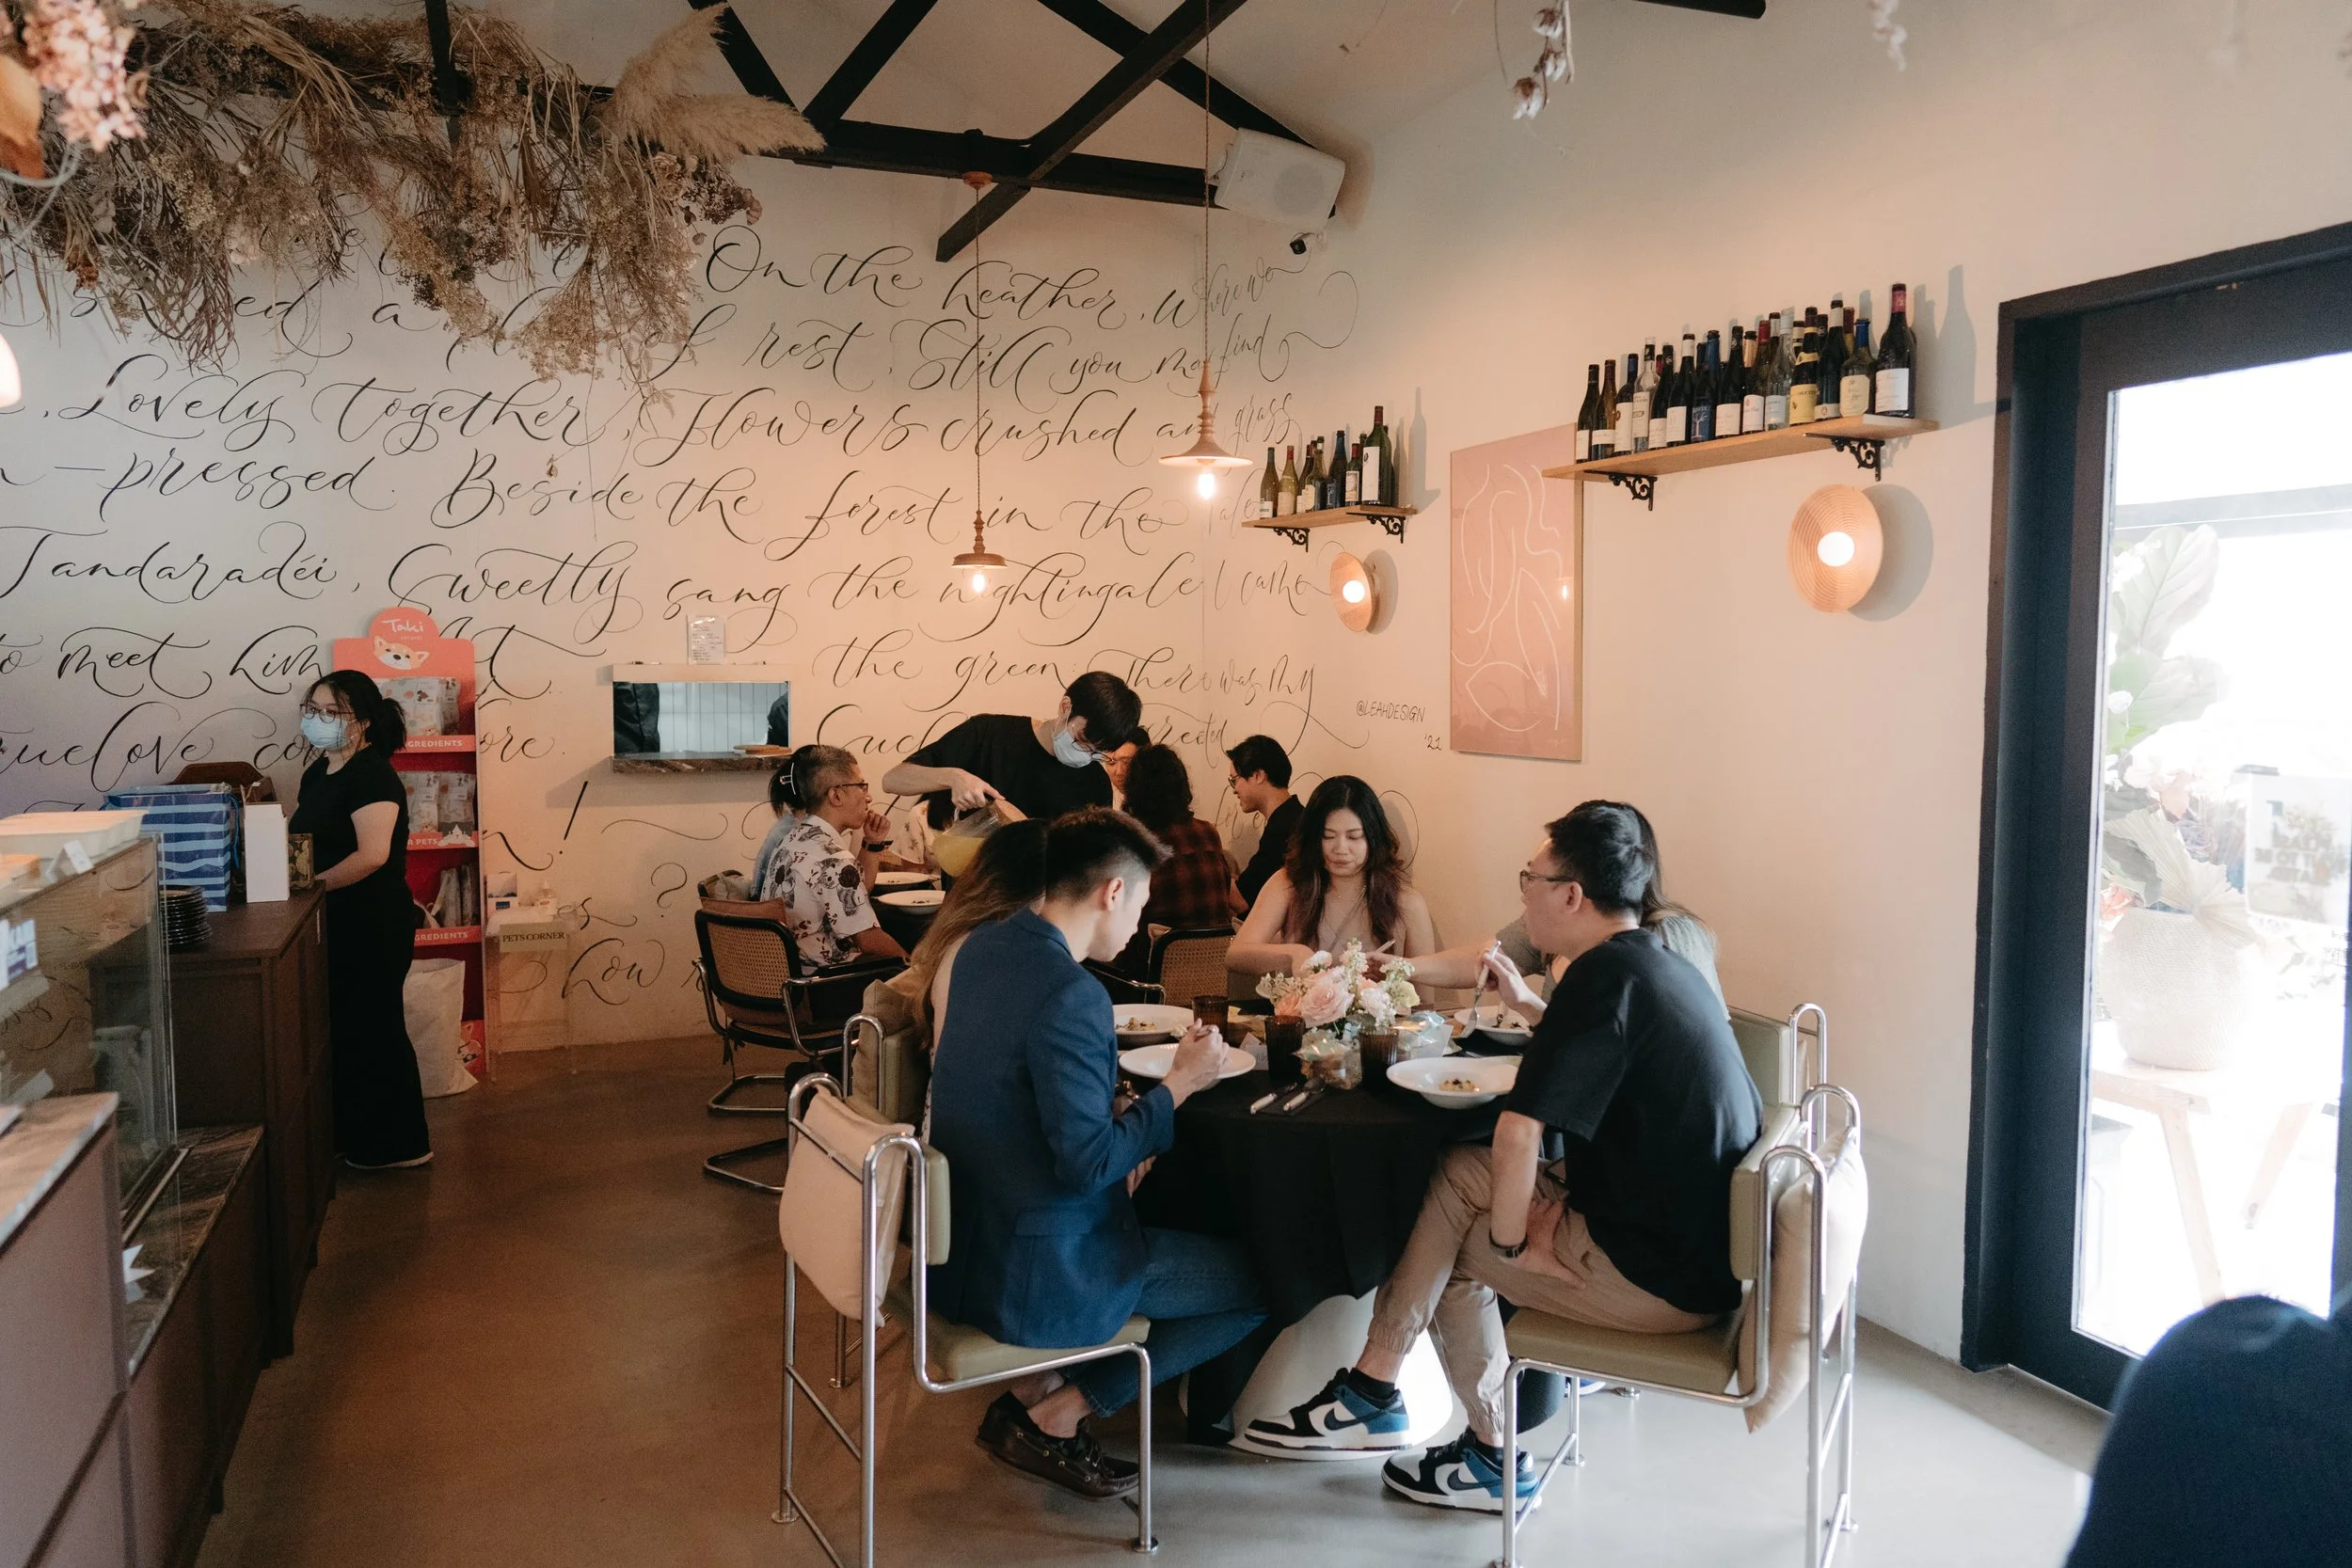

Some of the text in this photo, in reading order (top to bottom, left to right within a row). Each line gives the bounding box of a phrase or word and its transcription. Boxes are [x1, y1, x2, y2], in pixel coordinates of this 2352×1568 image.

[706, 225, 807, 293] On
[810, 245, 923, 308] the
[890, 319, 1072, 414] Still
[1049, 351, 1152, 394] you
[58, 354, 306, 451] Lovely
[633, 387, 929, 467] Flowers
[941, 389, 1153, 467] crushed
[1156, 403, 1218, 440] an
[431, 449, 644, 529] Beside
[657, 467, 764, 544] the
[764, 470, 963, 561] forest
[987, 497, 1053, 531] in
[1060, 487, 1188, 555] the
[389, 541, 644, 644] Sweetly
[663, 578, 798, 653] sang
[808, 556, 919, 610] the
[918, 552, 1204, 647] nghtingale
[1241, 561, 1332, 616] came
[58, 626, 213, 699] meet
[812, 629, 923, 688] the
[405, 739, 463, 748] GREDIENTS
[1357, 701, 1425, 722] @LEAHDESIGN
[502, 931, 564, 942] PETS CORNER
